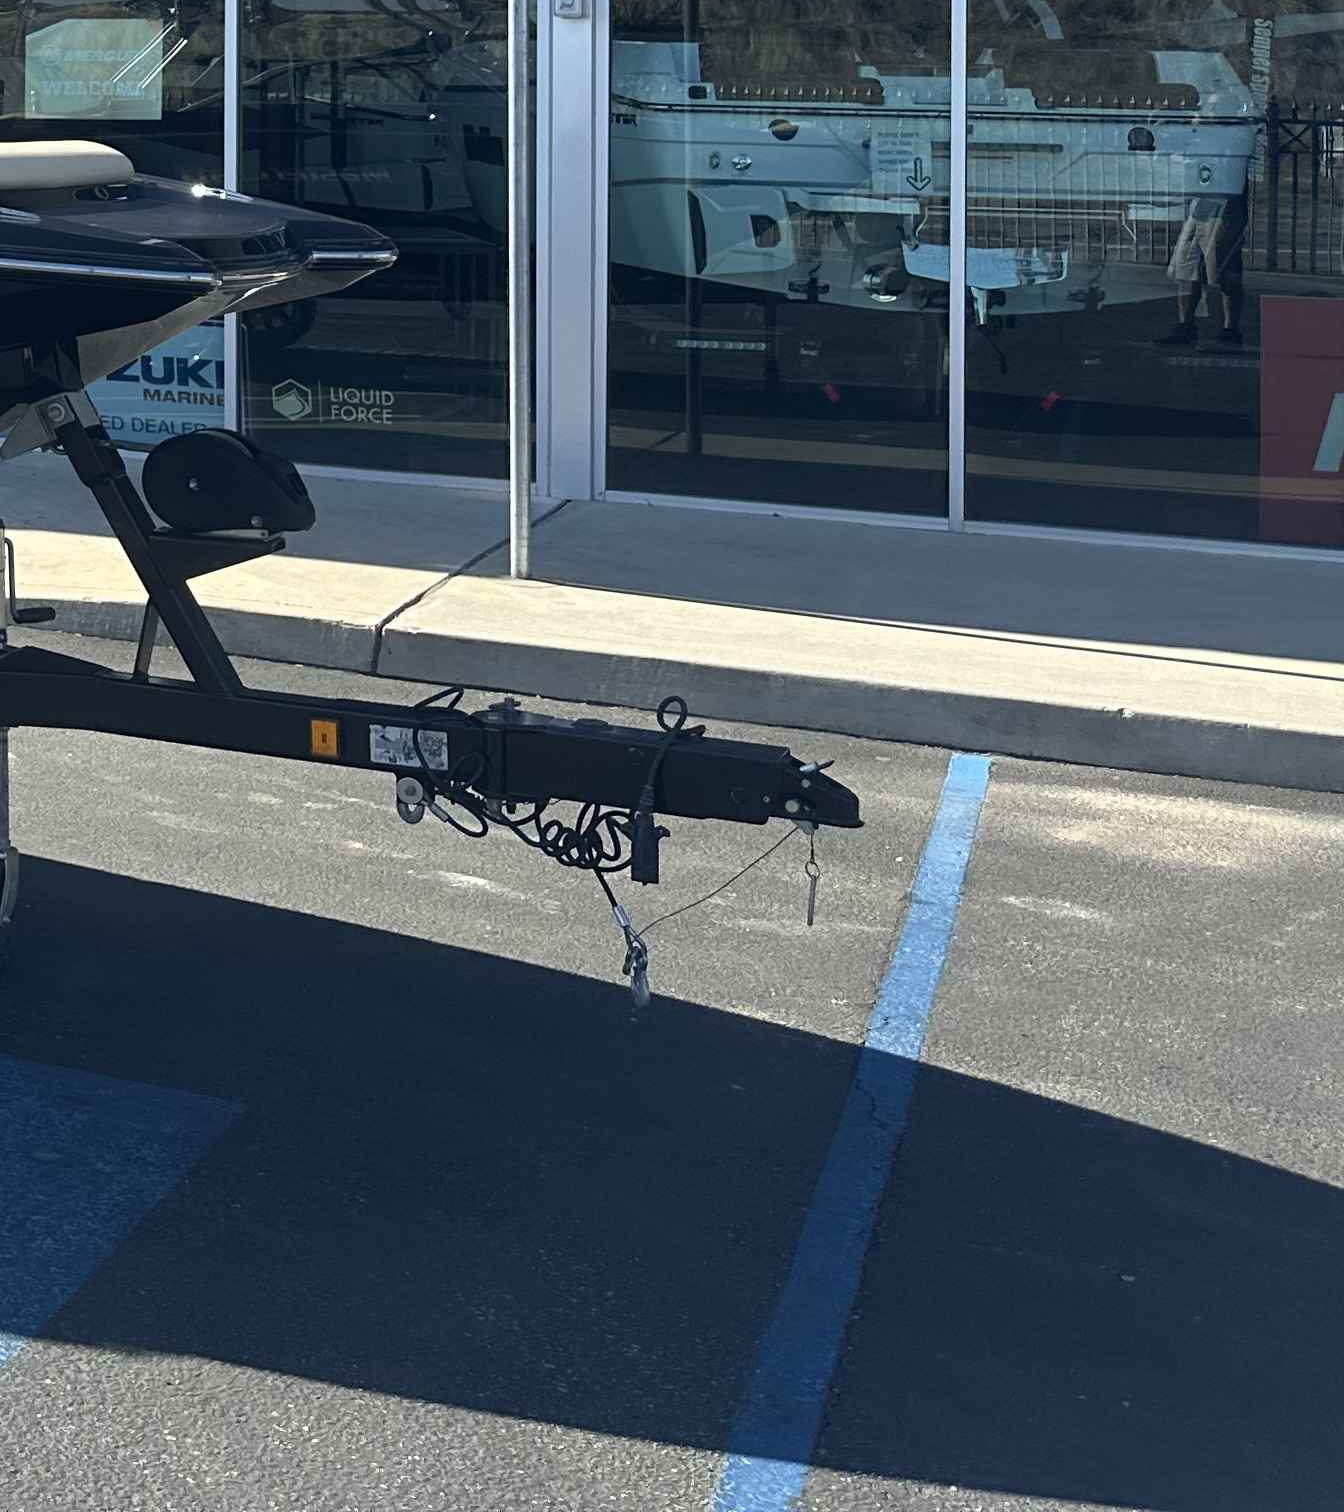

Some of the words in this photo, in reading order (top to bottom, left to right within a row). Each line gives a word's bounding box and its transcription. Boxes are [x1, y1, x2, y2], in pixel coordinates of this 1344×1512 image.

[106, 355, 225, 390] ZUKI
[330, 387, 394, 406] LIQUID
[331, 405, 393, 424] FORCE
